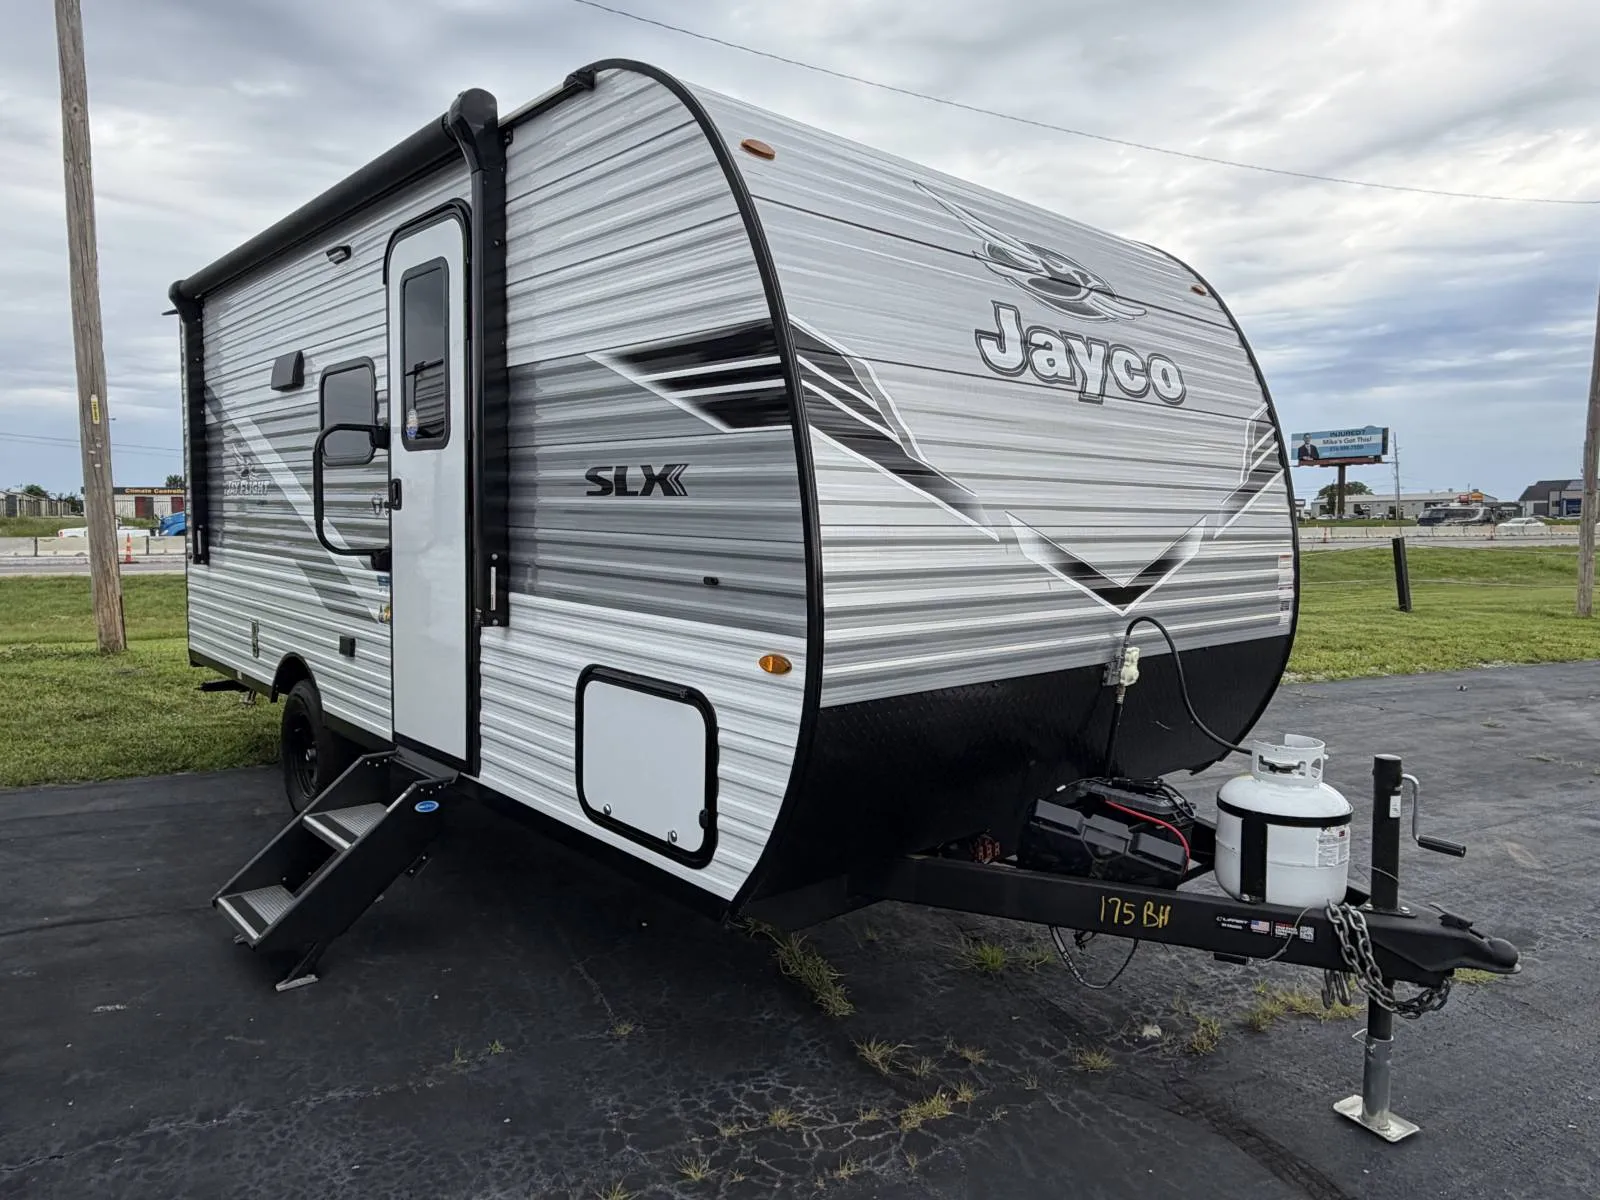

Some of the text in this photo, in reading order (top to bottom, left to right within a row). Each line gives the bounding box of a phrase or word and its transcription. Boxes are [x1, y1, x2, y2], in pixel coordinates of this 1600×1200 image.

[975, 300, 1187, 405] Jayco
[1322, 438, 1343, 446] Mike's
[1329, 429, 1367, 438] INJURED?
[584, 463, 690, 497] SLX
[1100, 896, 1171, 928] 175 BH
